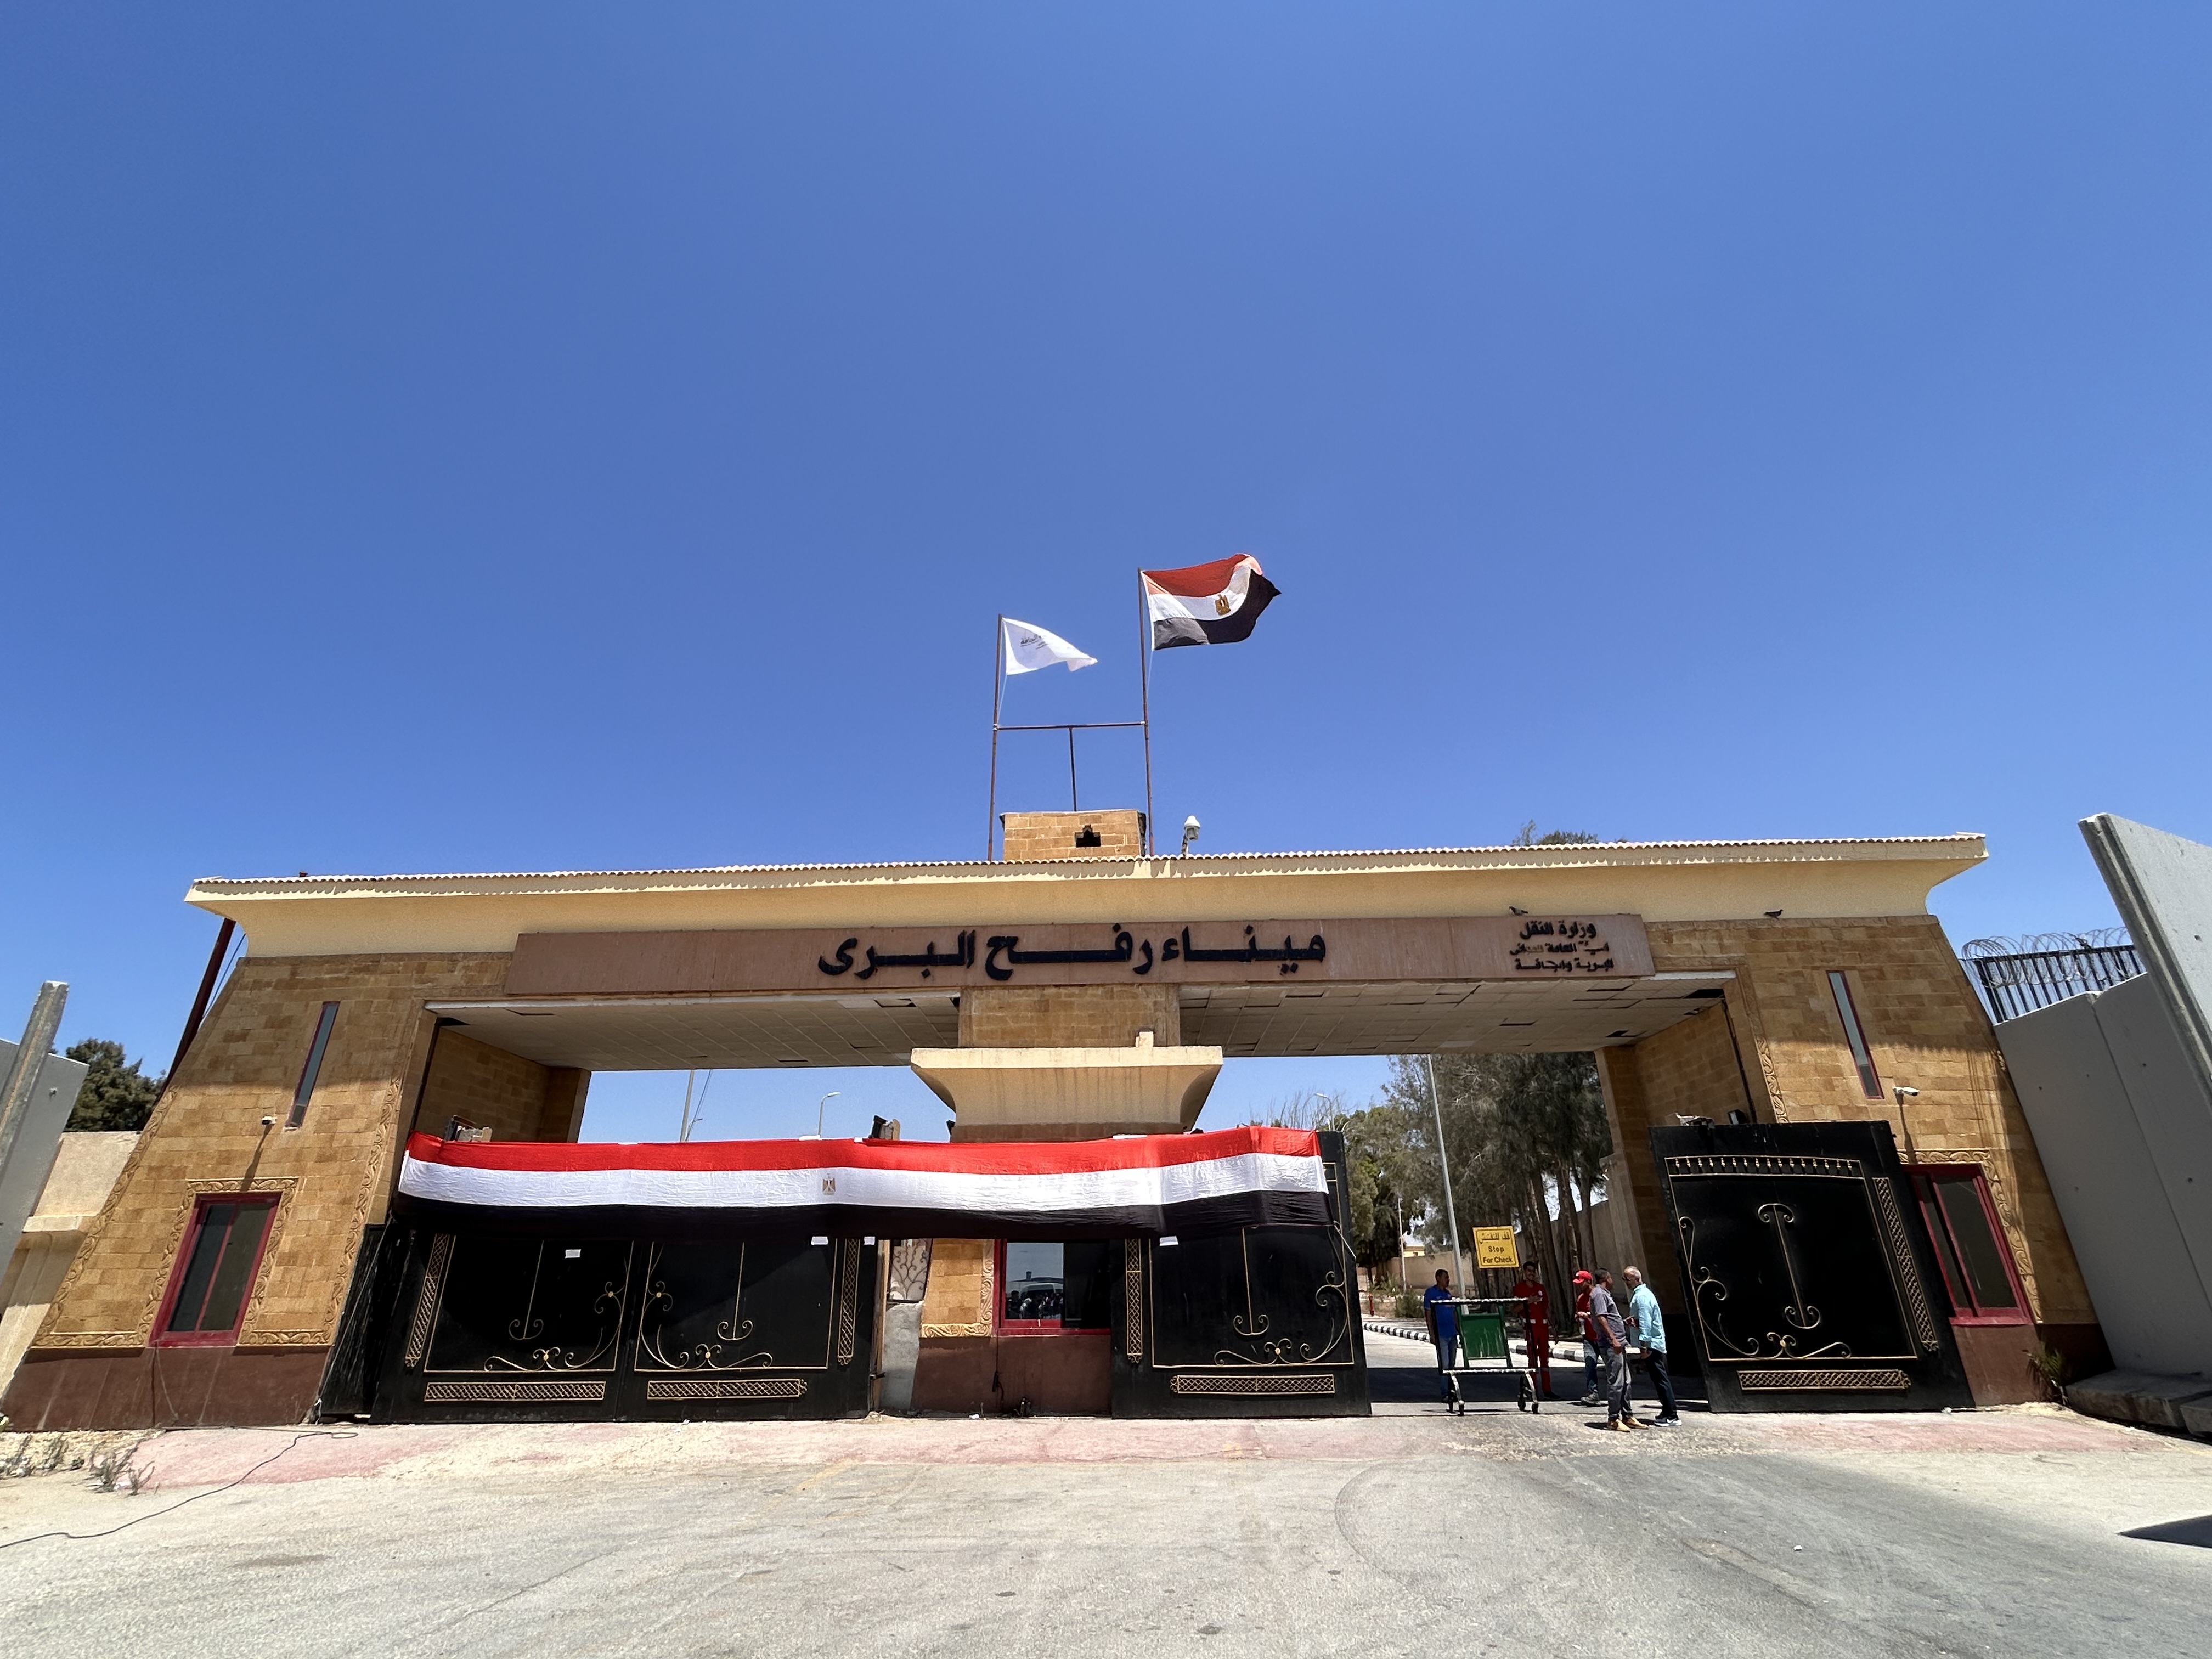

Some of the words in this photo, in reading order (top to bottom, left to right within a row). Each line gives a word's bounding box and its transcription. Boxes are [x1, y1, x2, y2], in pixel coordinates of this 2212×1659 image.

[1520, 921, 1554, 939] النقل
[1558, 919, 1596, 939] وزارة
[985, 923, 1154, 981] رفح
[1161, 925, 1325, 973] ميناء
[1544, 942, 1577, 953] العامة
[1514, 957, 1573, 973] والجافة
[1573, 957, 1615, 972] البرية
